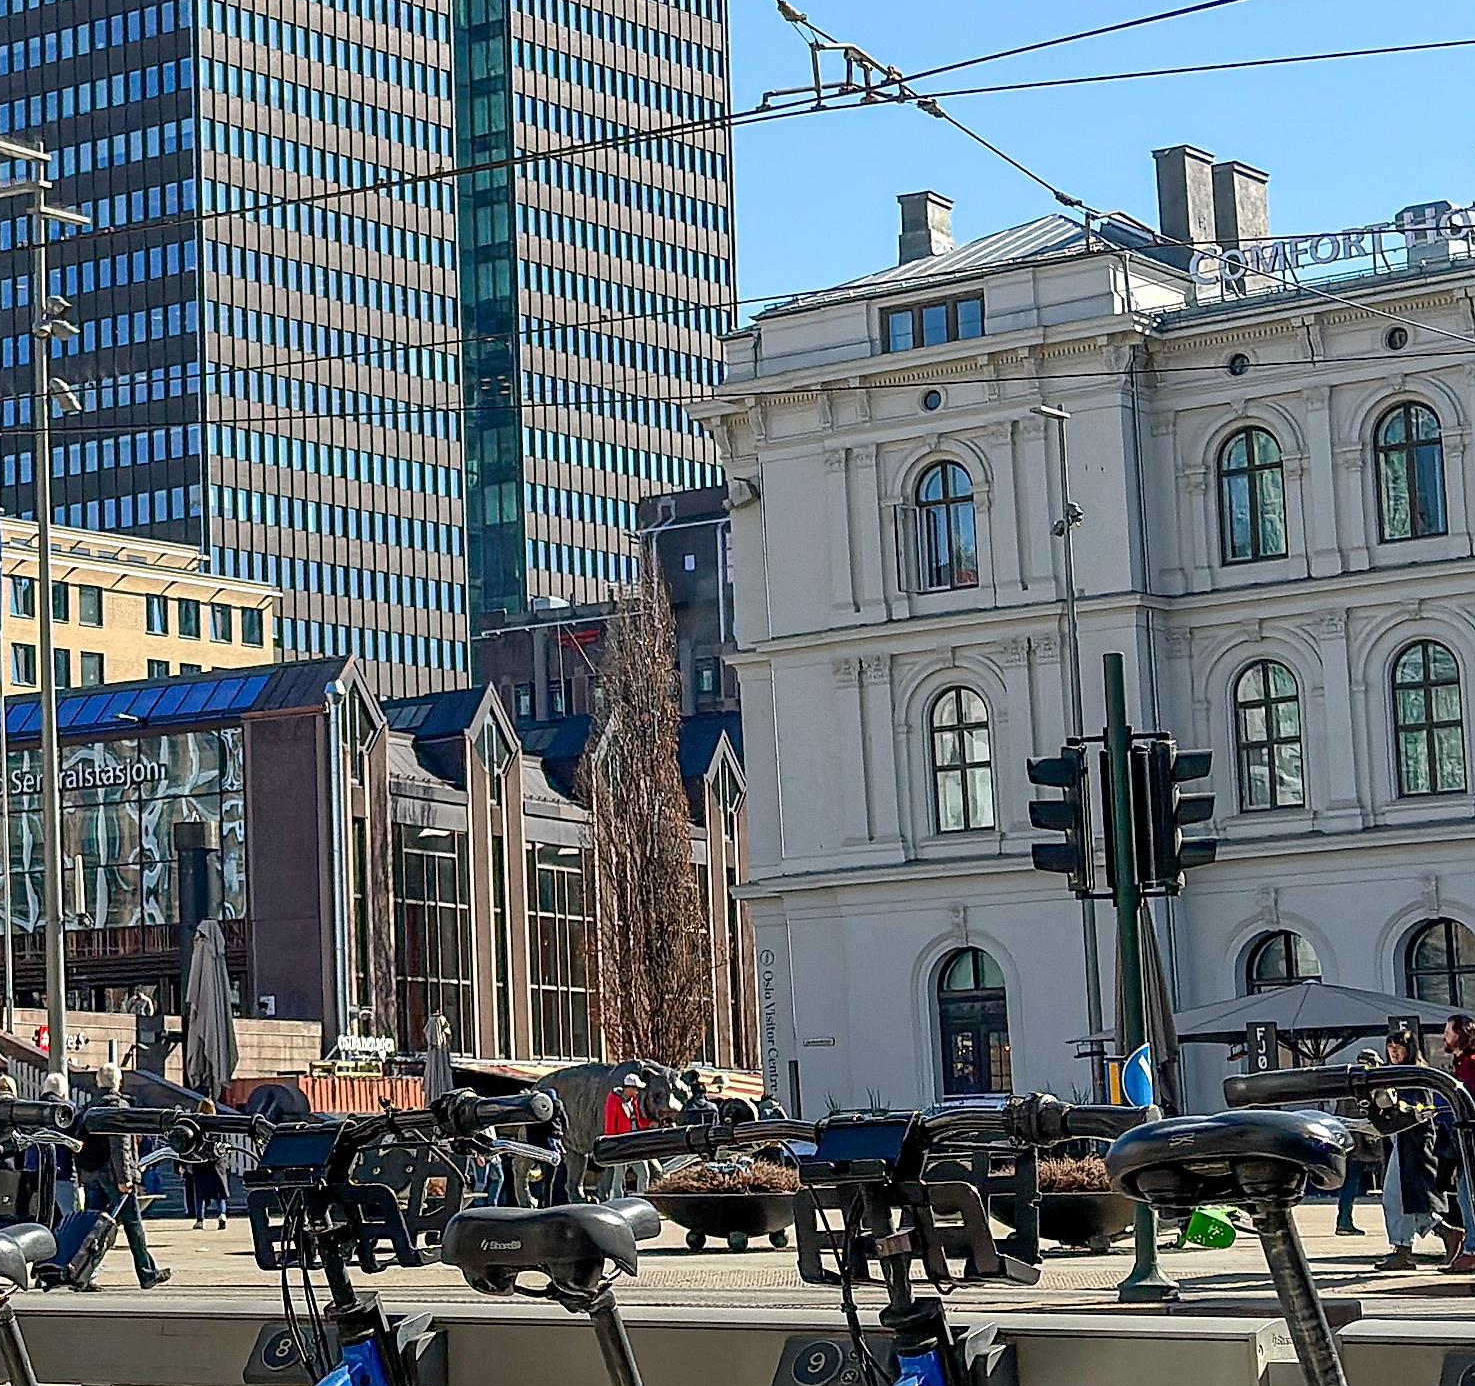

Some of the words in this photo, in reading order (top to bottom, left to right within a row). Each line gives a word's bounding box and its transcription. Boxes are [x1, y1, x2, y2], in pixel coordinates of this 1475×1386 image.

[763, 970, 775, 1000] Oslo
[764, 1002, 777, 1046] Visitor
[276, 1338, 293, 1357] 8
[807, 1351, 826, 1374] 9
